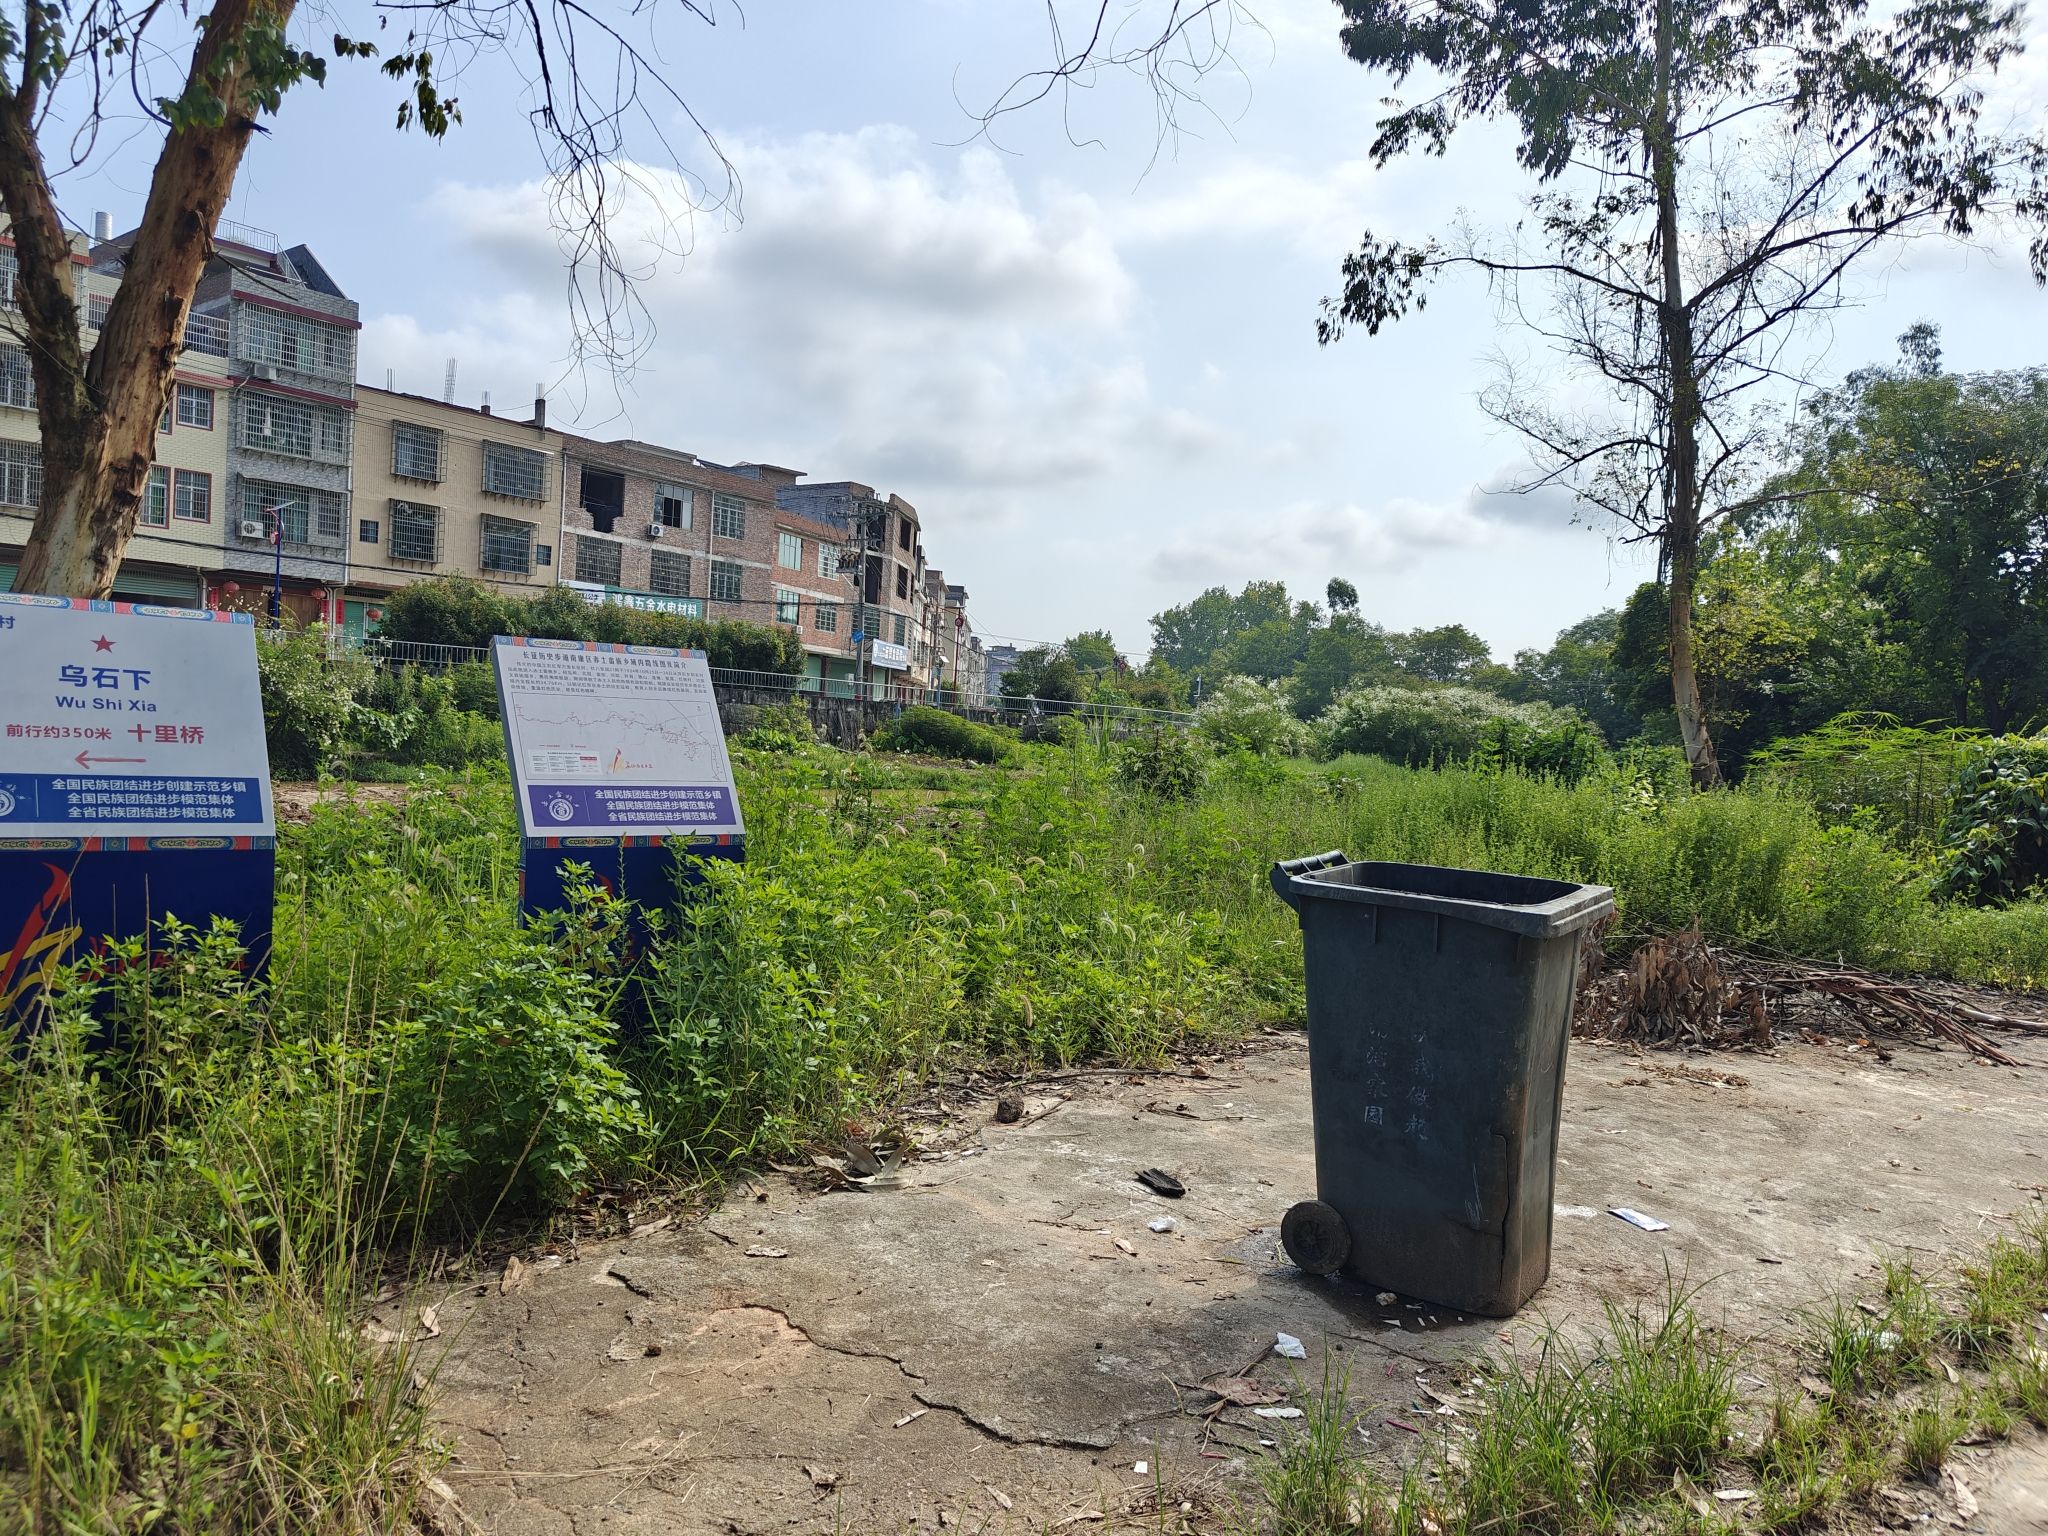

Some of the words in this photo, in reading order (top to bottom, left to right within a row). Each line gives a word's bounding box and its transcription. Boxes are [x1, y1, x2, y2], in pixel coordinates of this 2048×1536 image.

[58, 664, 151, 690] 乌石下
[55, 695, 86, 709] Wu
[92, 698, 122, 711] Shi
[129, 699, 157, 712] Xia
[6, 724, 112, 741] 前行约350米
[127, 723, 205, 745] 十里桥
[51, 778, 247, 793] 全国民族团结进步创建示范乡镇
[67, 792, 235, 806] 全国民族团结进步模范集体
[594, 789, 722, 800] 全国民族团结进步创建示范乡镇
[606, 800, 716, 811] 全国民族团结进步模范集体
[68, 806, 236, 820] 全省民族团结进步模范集体
[608, 811, 718, 822] 全省民族团结进步模范集体
